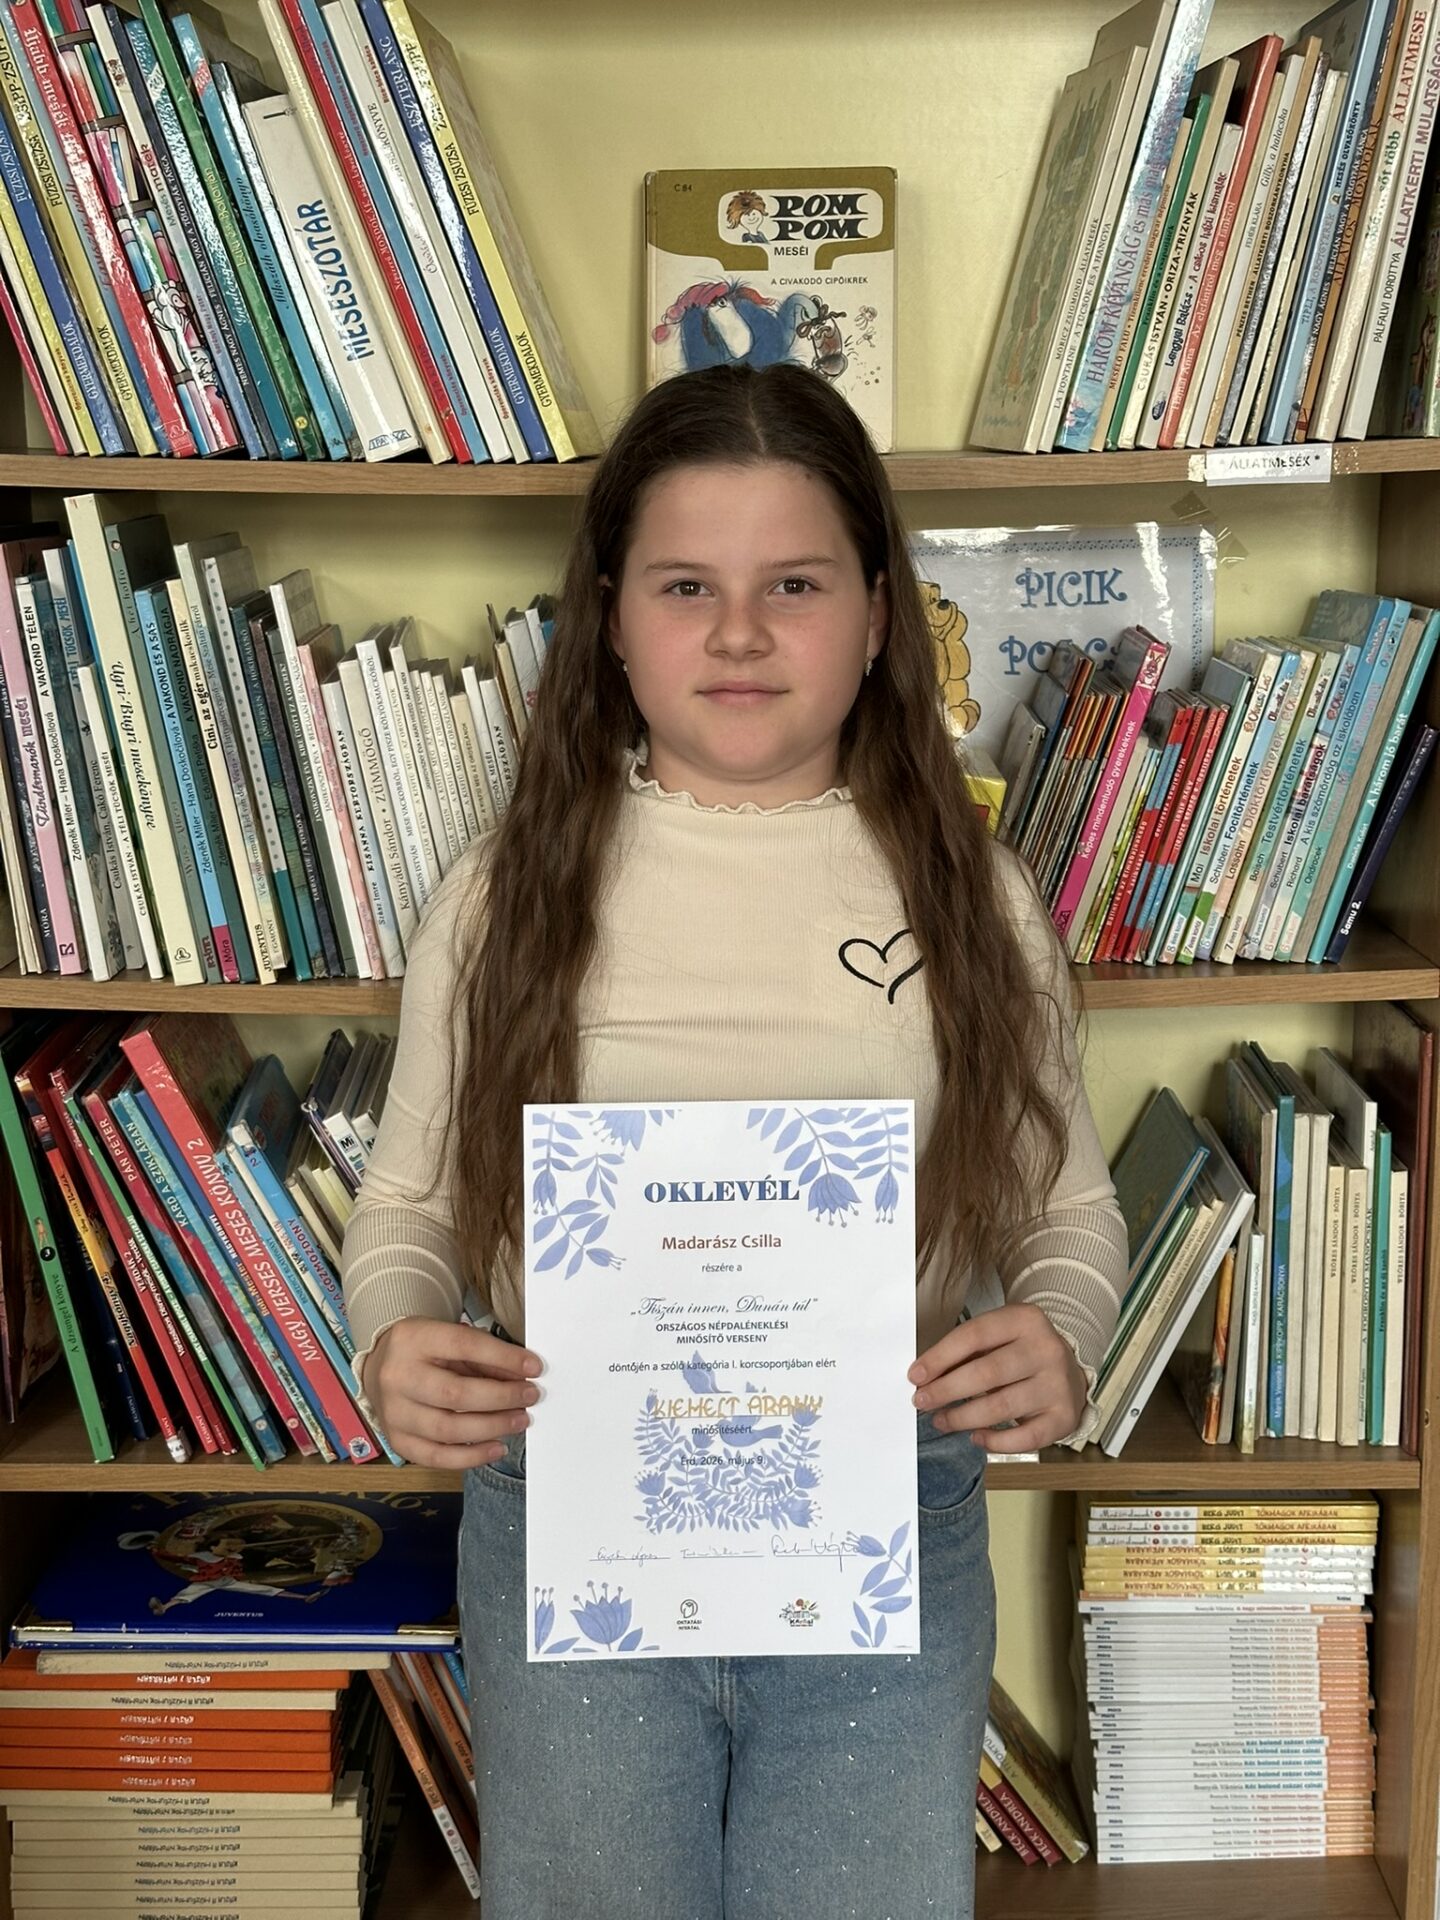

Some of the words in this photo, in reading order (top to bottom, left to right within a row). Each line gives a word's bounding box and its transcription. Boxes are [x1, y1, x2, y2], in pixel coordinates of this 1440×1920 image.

[374, 34, 422, 129] ESZTERLÁNC
[1388, 8, 1430, 123] ÁLLATMESE
[136, 141, 166, 193] matek
[442, 141, 466, 181] ZSUZSA
[1259, 161, 1276, 187] Gilly,
[1269, 107, 1289, 151] halacska
[1381, 128, 1401, 166] több
[156, 193, 178, 227] Mesés
[455, 180, 479, 216] FÜZESI
[770, 193, 869, 218] POM
[1389, 148, 1424, 248] ÁLLATKERTI
[771, 218, 869, 242] POM
[774, 246, 808, 256] MESÉI
[1065, 277, 1082, 324] ZSIGMOND
[1077, 216, 1099, 272] ÁLLATMESÉK
[1148, 299, 1168, 343] ISTVÁN
[1161, 190, 1198, 293] ORIZA-TRIZNYÁK
[293, 198, 376, 364] MESESZÓTÁR
[1083, 319, 1119, 384] HÁROM
[1134, 188, 1154, 218] más
[1381, 250, 1401, 299] DOROTTYA
[1371, 300, 1390, 343] PÁLFALVI
[60, 319, 100, 400] GYERMEKDALOK
[96, 323, 133, 402] GYERMEKDALOK
[487, 326, 525, 405] GYERMEKDALOK
[1163, 327, 1186, 368] Lengyel
[514, 330, 553, 408] GYERMEKDALOK
[1015, 568, 1128, 608] PICIK
[21, 605, 38, 641] TÉLEN
[145, 621, 158, 642] SAS
[30, 641, 47, 687] VAKOND
[156, 666, 174, 710] VAKOND
[193, 680, 210, 705] egér
[108, 660, 142, 747] Ugri-Bugri
[129, 746, 159, 830] mesekönyve
[203, 723, 218, 749] Cini,
[1369, 757, 1391, 795] három
[1388, 711, 1408, 744] barát
[54, 767, 68, 793] Hana
[87, 759, 102, 792] Ferenc
[358, 726, 386, 803] ZÜMMÖGŐ
[94, 794, 108, 819] Cakó
[183, 782, 196, 806] Hana
[61, 803, 75, 826] Miler
[191, 815, 204, 839] Miler
[1190, 862, 1204, 883] Mai
[1198, 816, 1220, 855] Iskolai
[1212, 755, 1242, 816] történetek
[1208, 842, 1231, 884] Schubert
[1223, 760, 1260, 840] Focitörténetek
[1269, 850, 1288, 889] Schubert
[1283, 807, 1303, 845] Iskolai
[1296, 741, 1327, 806] barátságok
[100, 820, 116, 853] István,
[380, 817, 398, 859] Sándor
[107, 854, 122, 889] Csukás
[1225, 838, 1246, 879] Lassahn
[390, 861, 412, 910] Kányádi
[1339, 908, 1358, 936] Samu
[220, 938, 232, 962] Móra
[254, 923, 271, 972] JUVENTUS
[97, 1117, 124, 1157] PÉTER
[124, 1121, 165, 1185] SZIKLÁBAN
[117, 1156, 137, 1182] PÁN
[644, 1175, 801, 1204] OKLEVÉL
[165, 1195, 188, 1228] KARD
[223, 1206, 263, 1262] MESÉS
[662, 1234, 738, 1252] Madarász
[741, 1234, 782, 1249] Csilla
[702, 1261, 734, 1273] részére
[49, 1272, 67, 1305] könyve
[253, 1258, 295, 1319] VERSES
[735, 1294, 790, 1313] Dunán
[58, 1305, 78, 1344] dzsungel
[285, 1315, 322, 1365] NAGY
[656, 1320, 707, 1332] ORSZÁGOS
[708, 1320, 788, 1332] NÉPDALÉNEKLÉSI
[676, 1333, 724, 1344] MINŐSÍTŐ
[727, 1334, 768, 1344] VERSENY
[608, 1360, 650, 1374] döntőjén
[687, 1359, 730, 1374] kategória
[740, 1358, 814, 1372] korcsoportjában
[816, 1358, 836, 1368] elért
[654, 1396, 740, 1418] KIEMELT
[747, 1394, 823, 1416] ARANY
[728, 1456, 754, 1467] május
[973, 1792, 1013, 1834] ANDREA
[995, 1791, 1035, 1833] ANDREA
[1005, 1831, 1030, 1857] BECK
[1028, 1832, 1053, 1858] BECK
